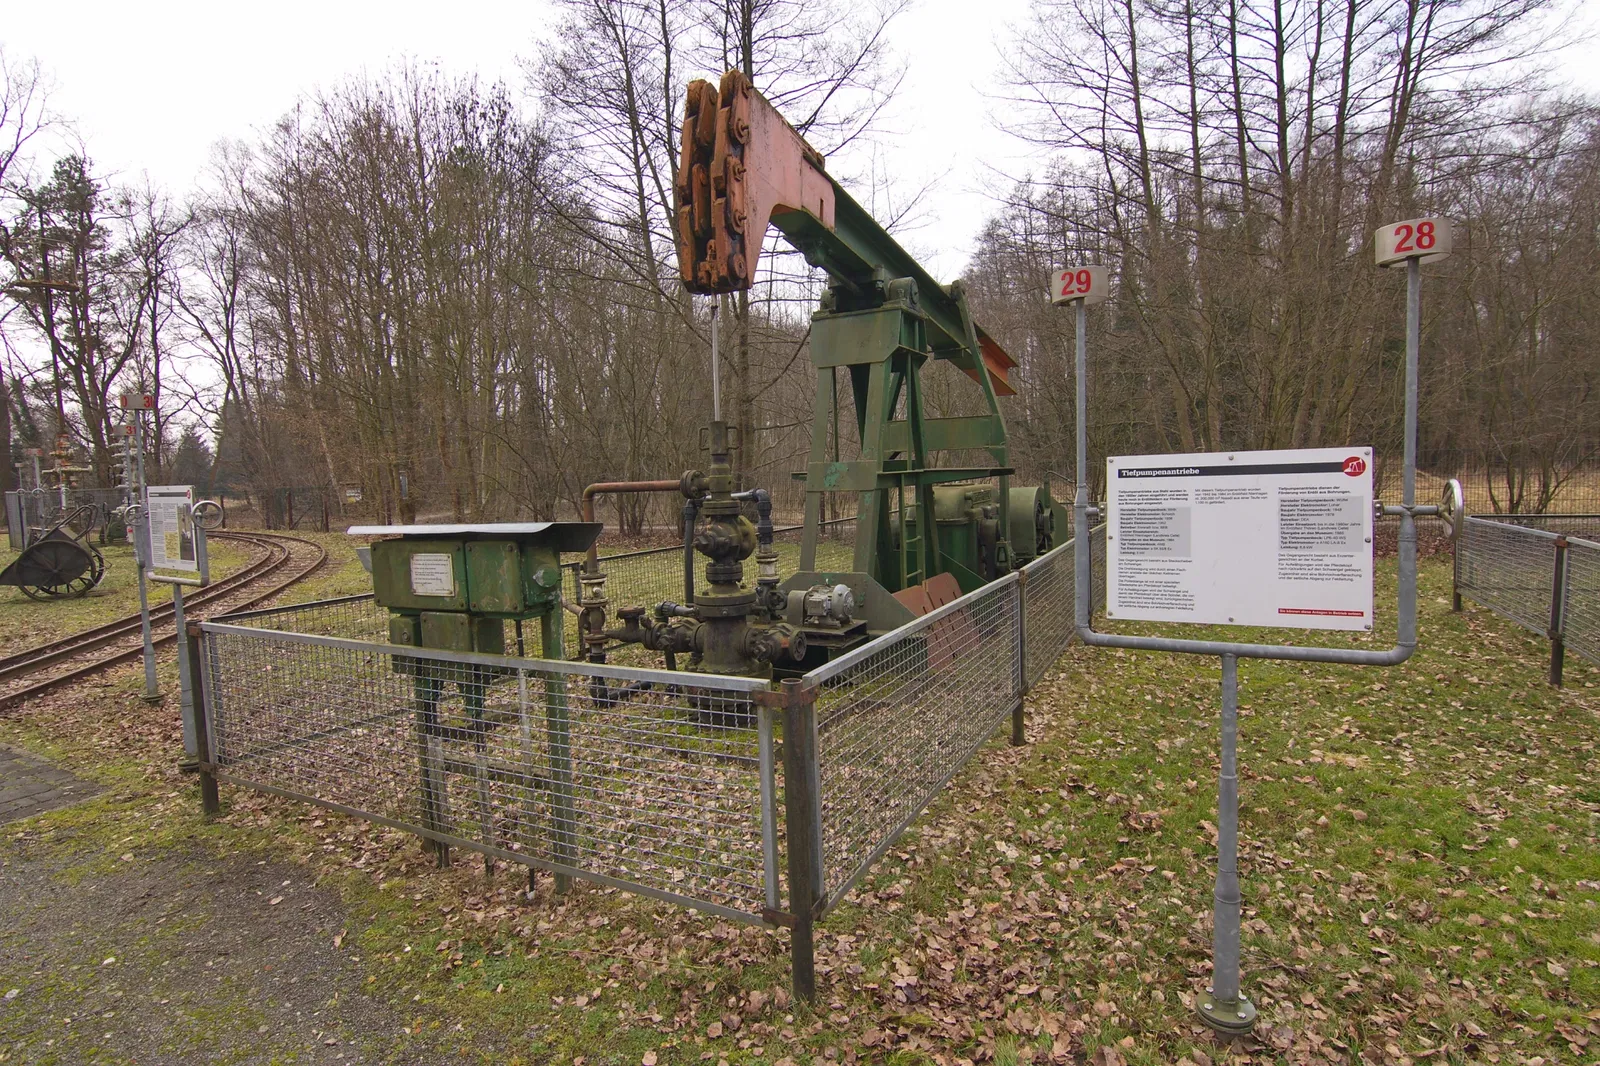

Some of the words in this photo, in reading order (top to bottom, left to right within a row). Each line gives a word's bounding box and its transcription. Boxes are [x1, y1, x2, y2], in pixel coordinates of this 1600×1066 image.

[1394, 221, 1436, 254] 28
[1061, 269, 1091, 296] 29
[1122, 468, 1200, 476] Tiefpumpenantriebe
